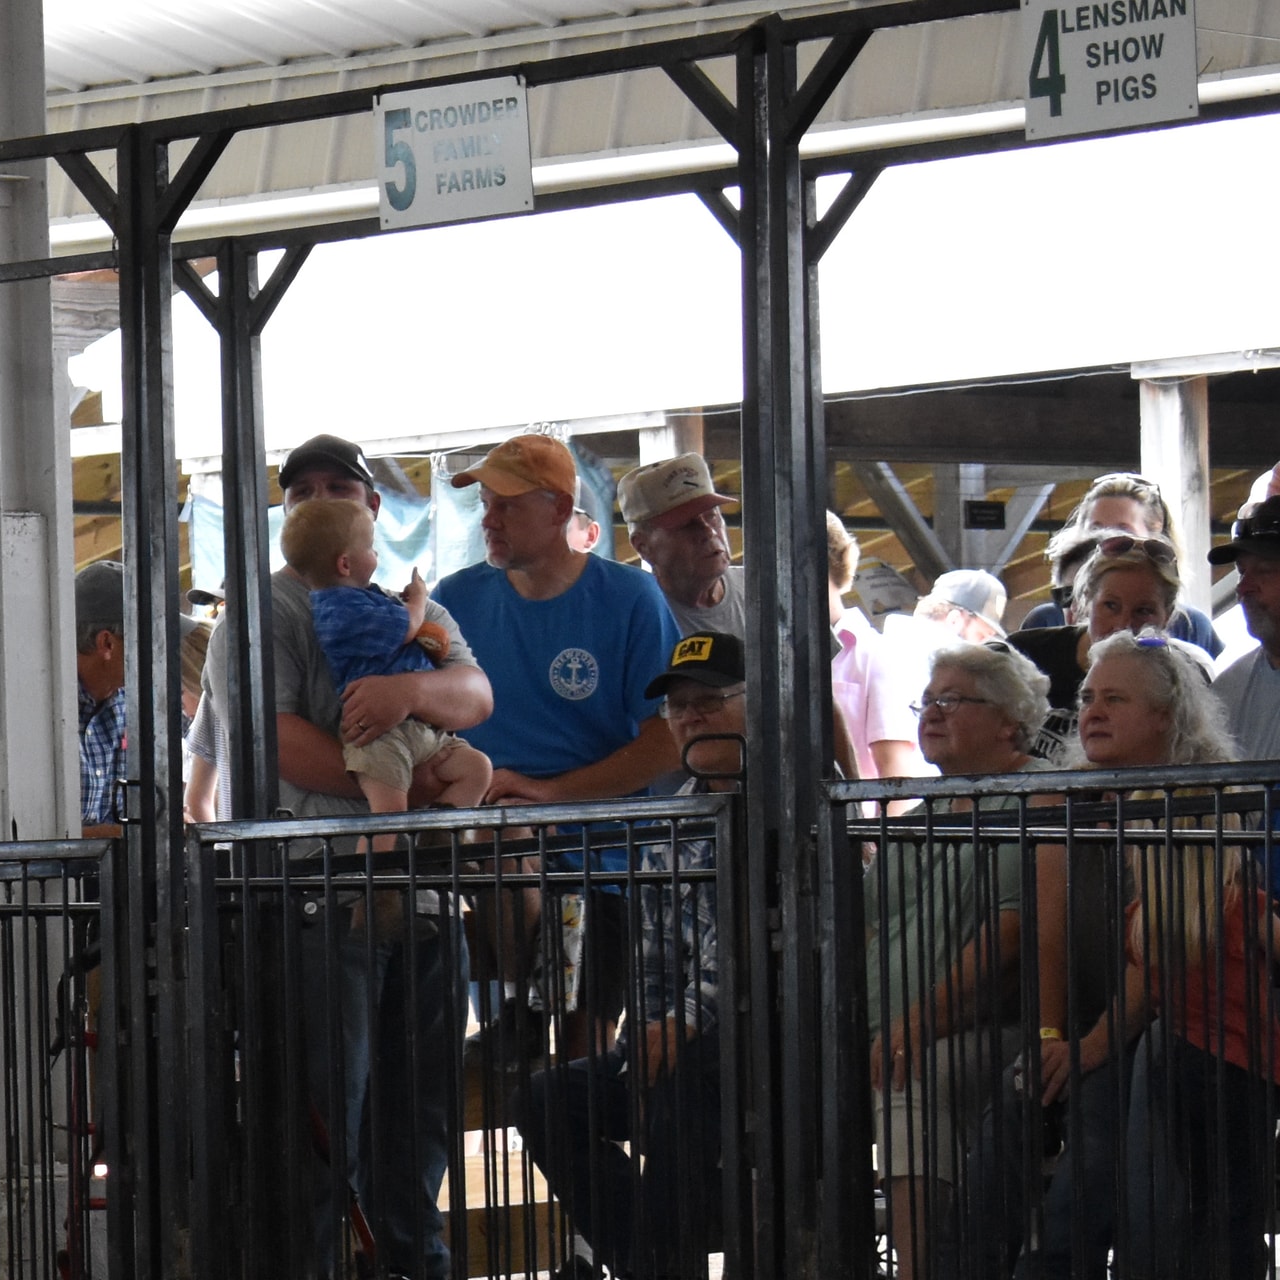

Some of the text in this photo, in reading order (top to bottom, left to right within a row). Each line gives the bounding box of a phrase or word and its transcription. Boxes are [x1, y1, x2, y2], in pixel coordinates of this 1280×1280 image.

[1061, 0, 1187, 34] LENSMAN
[1029, 9, 1066, 117] 4
[1086, 33, 1164, 68] SHOW
[1096, 73, 1157, 105] PIGS
[414, 97, 519, 132] CROWDER
[384, 107, 417, 211] 5
[435, 165, 506, 195] FARMS
[678, 641, 706, 657] CAT
